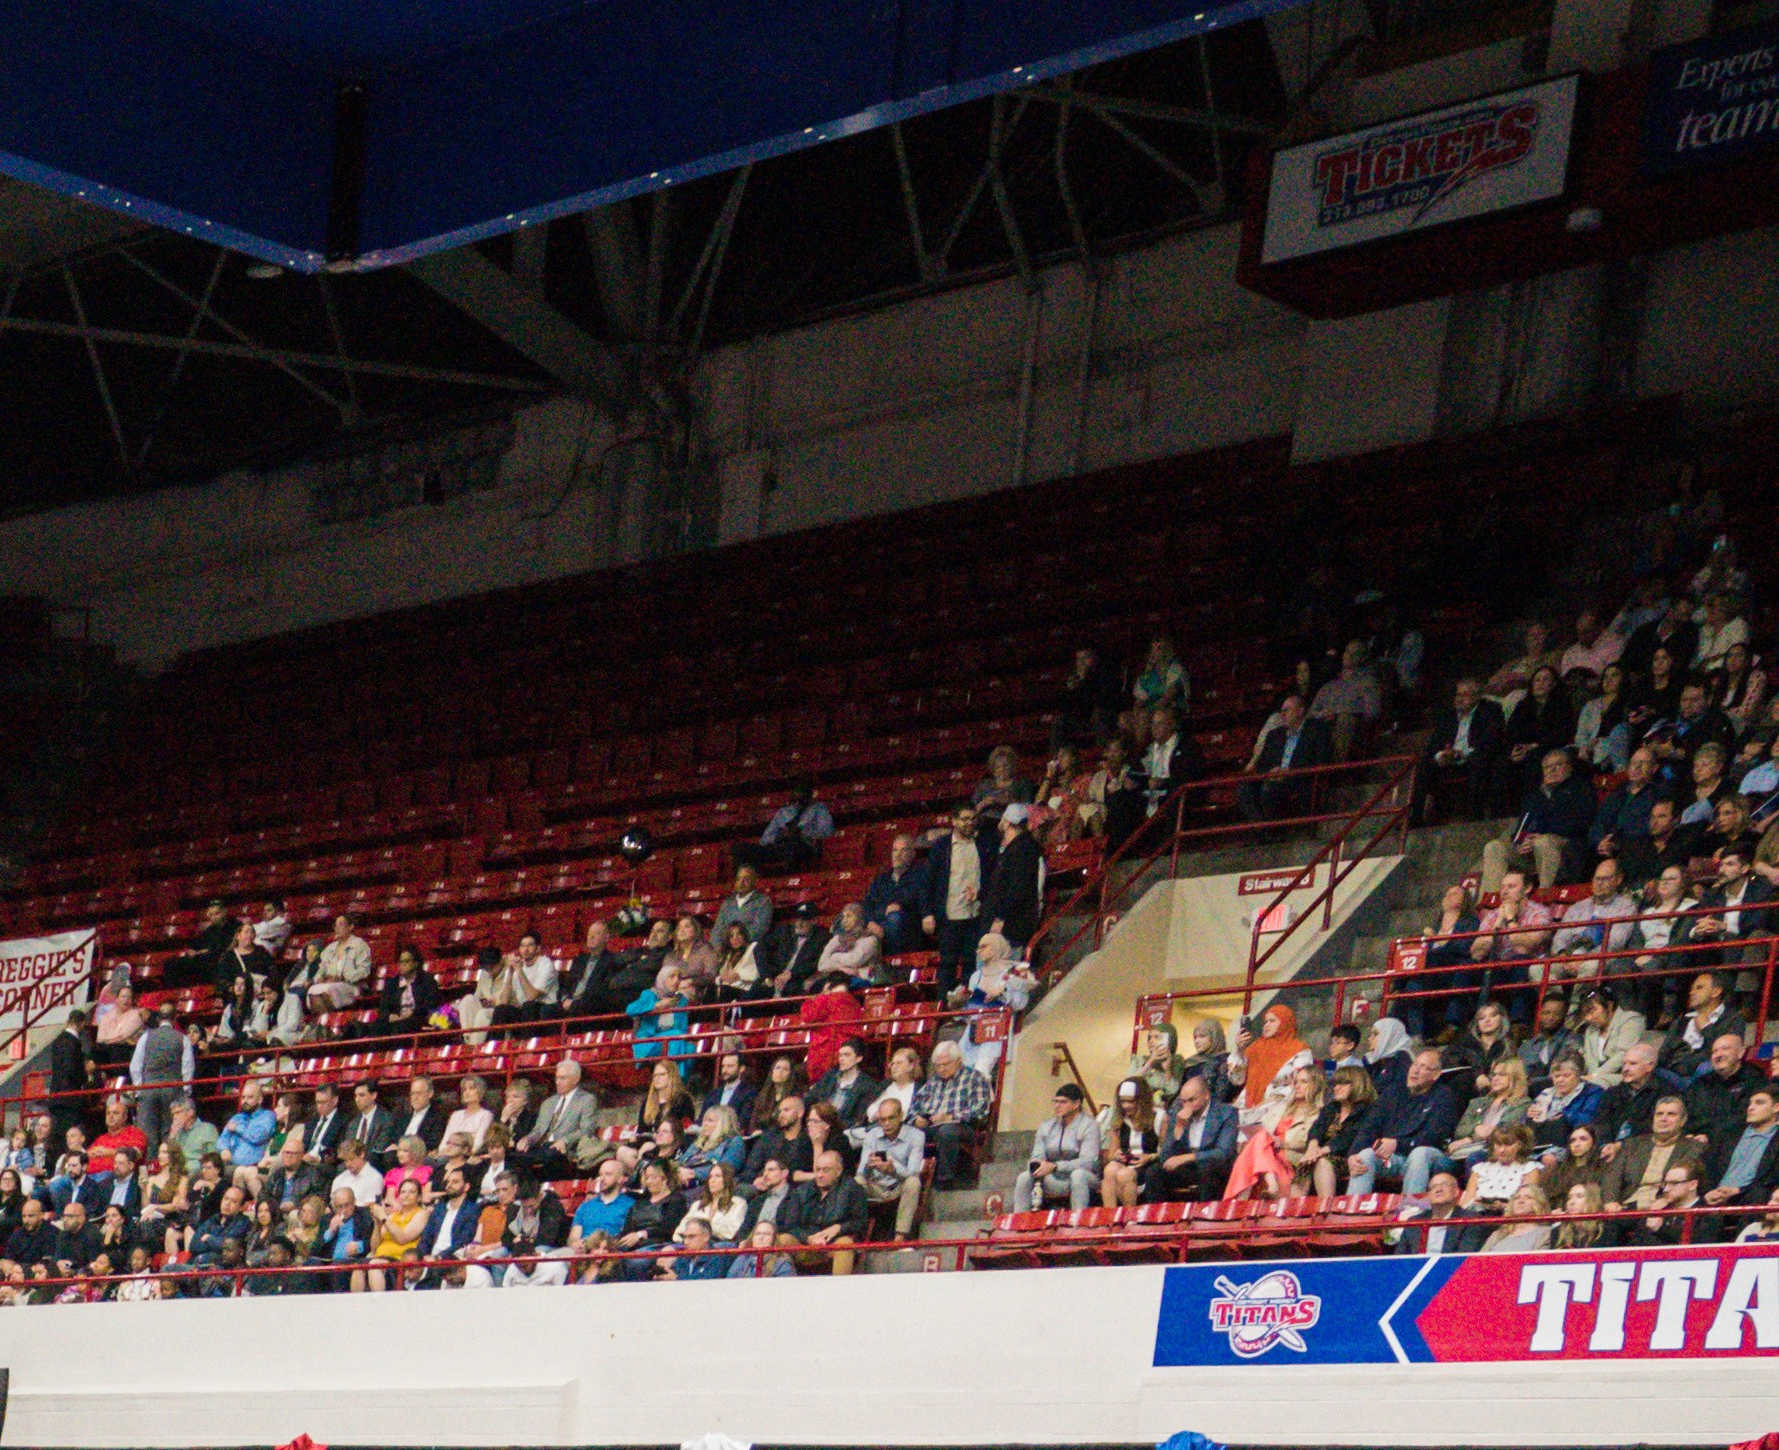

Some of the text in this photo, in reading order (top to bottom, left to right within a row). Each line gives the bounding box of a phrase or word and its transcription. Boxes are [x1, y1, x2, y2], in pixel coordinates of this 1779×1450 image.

[1317, 102, 1539, 207] TICKETS
[1401, 956, 1417, 970] 12
[1150, 1012, 1164, 1026] 12
[1352, 999, 1369, 1022] F
[984, 1025, 996, 1038] 11
[1216, 1301, 1316, 1326] TITANS
[1517, 1257, 1779, 1353] TITA
